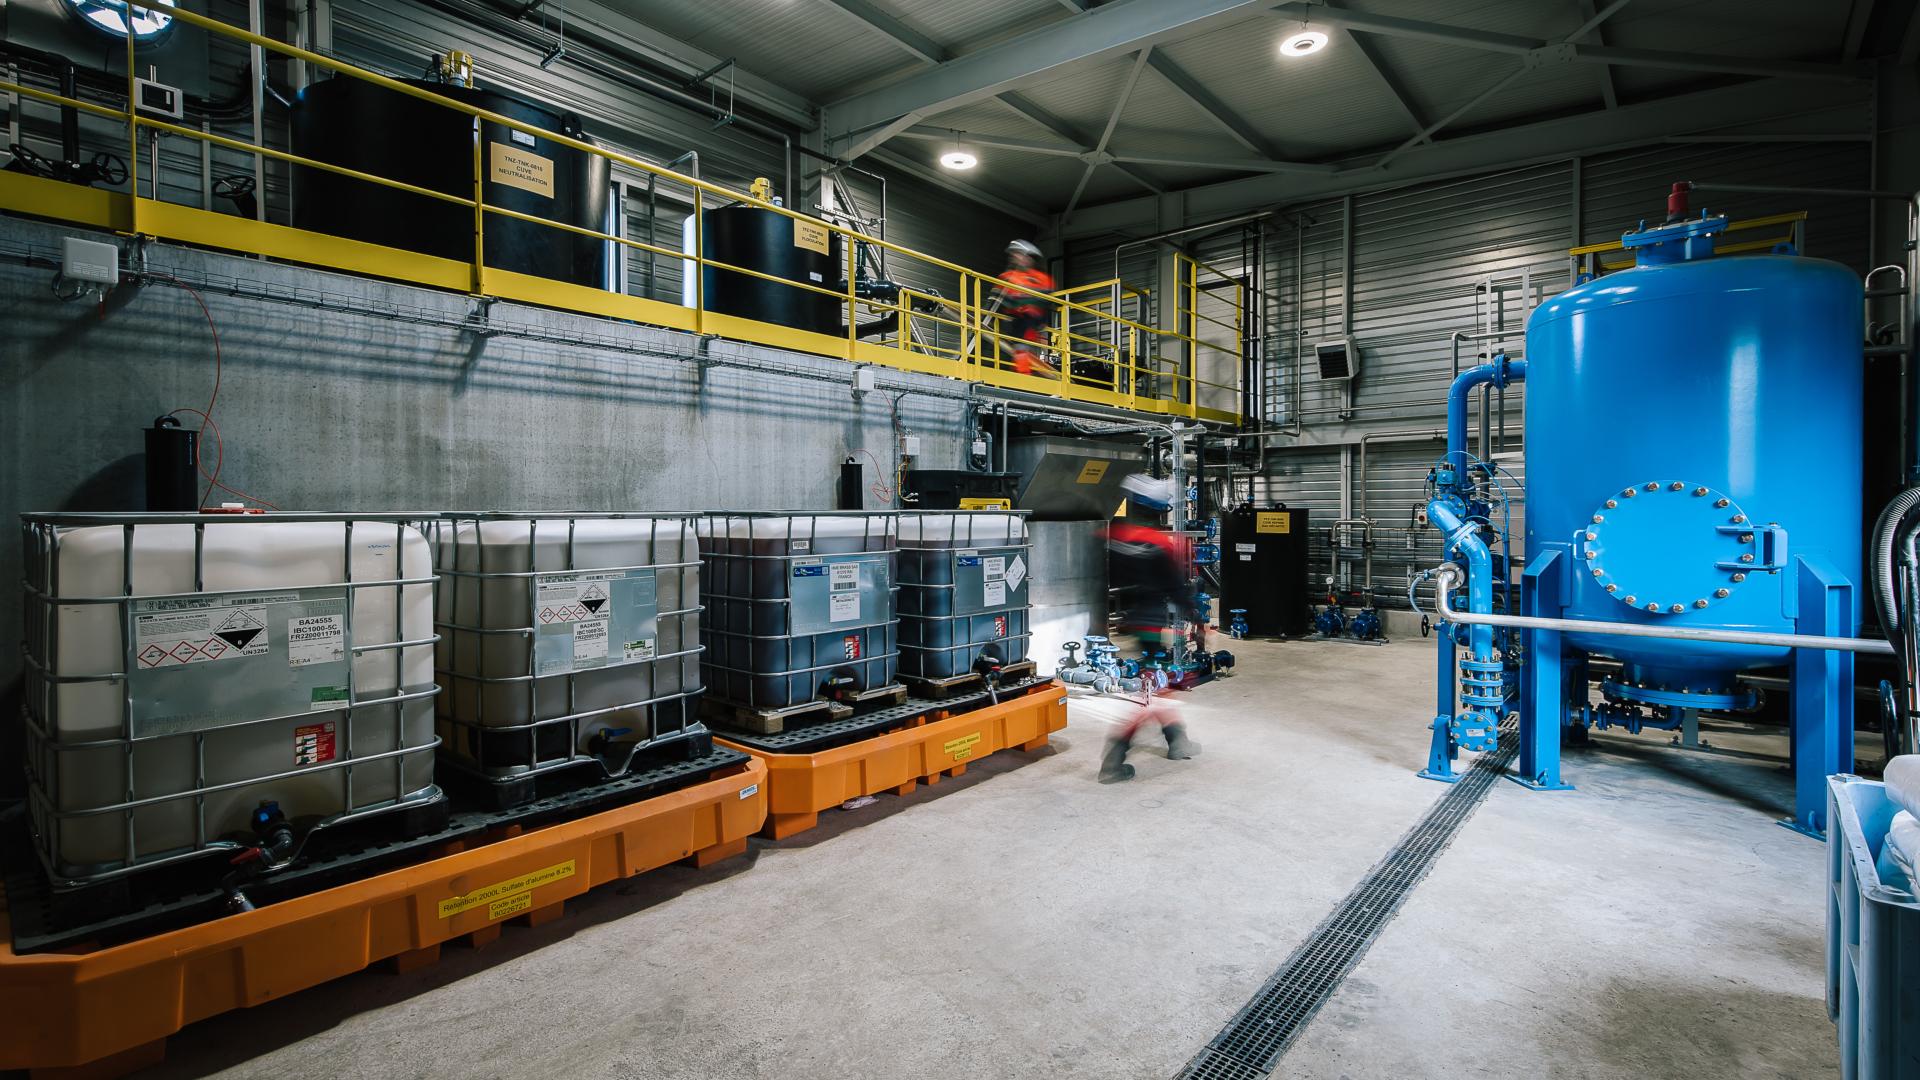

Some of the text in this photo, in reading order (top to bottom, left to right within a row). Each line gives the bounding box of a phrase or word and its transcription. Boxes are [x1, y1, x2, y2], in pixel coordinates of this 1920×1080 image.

[516, 165, 532, 175] CUVE
[498, 167, 548, 187] NEUTRALISATION
[298, 617, 333, 626] BA24555
[293, 624, 337, 634] IBC1000-5C
[290, 630, 341, 640] FR2200011798
[478, 889, 500, 900] 2000L
[501, 881, 525, 893] Sulfate
[525, 871, 555, 886] d'alumine
[491, 893, 530, 911] Code article
